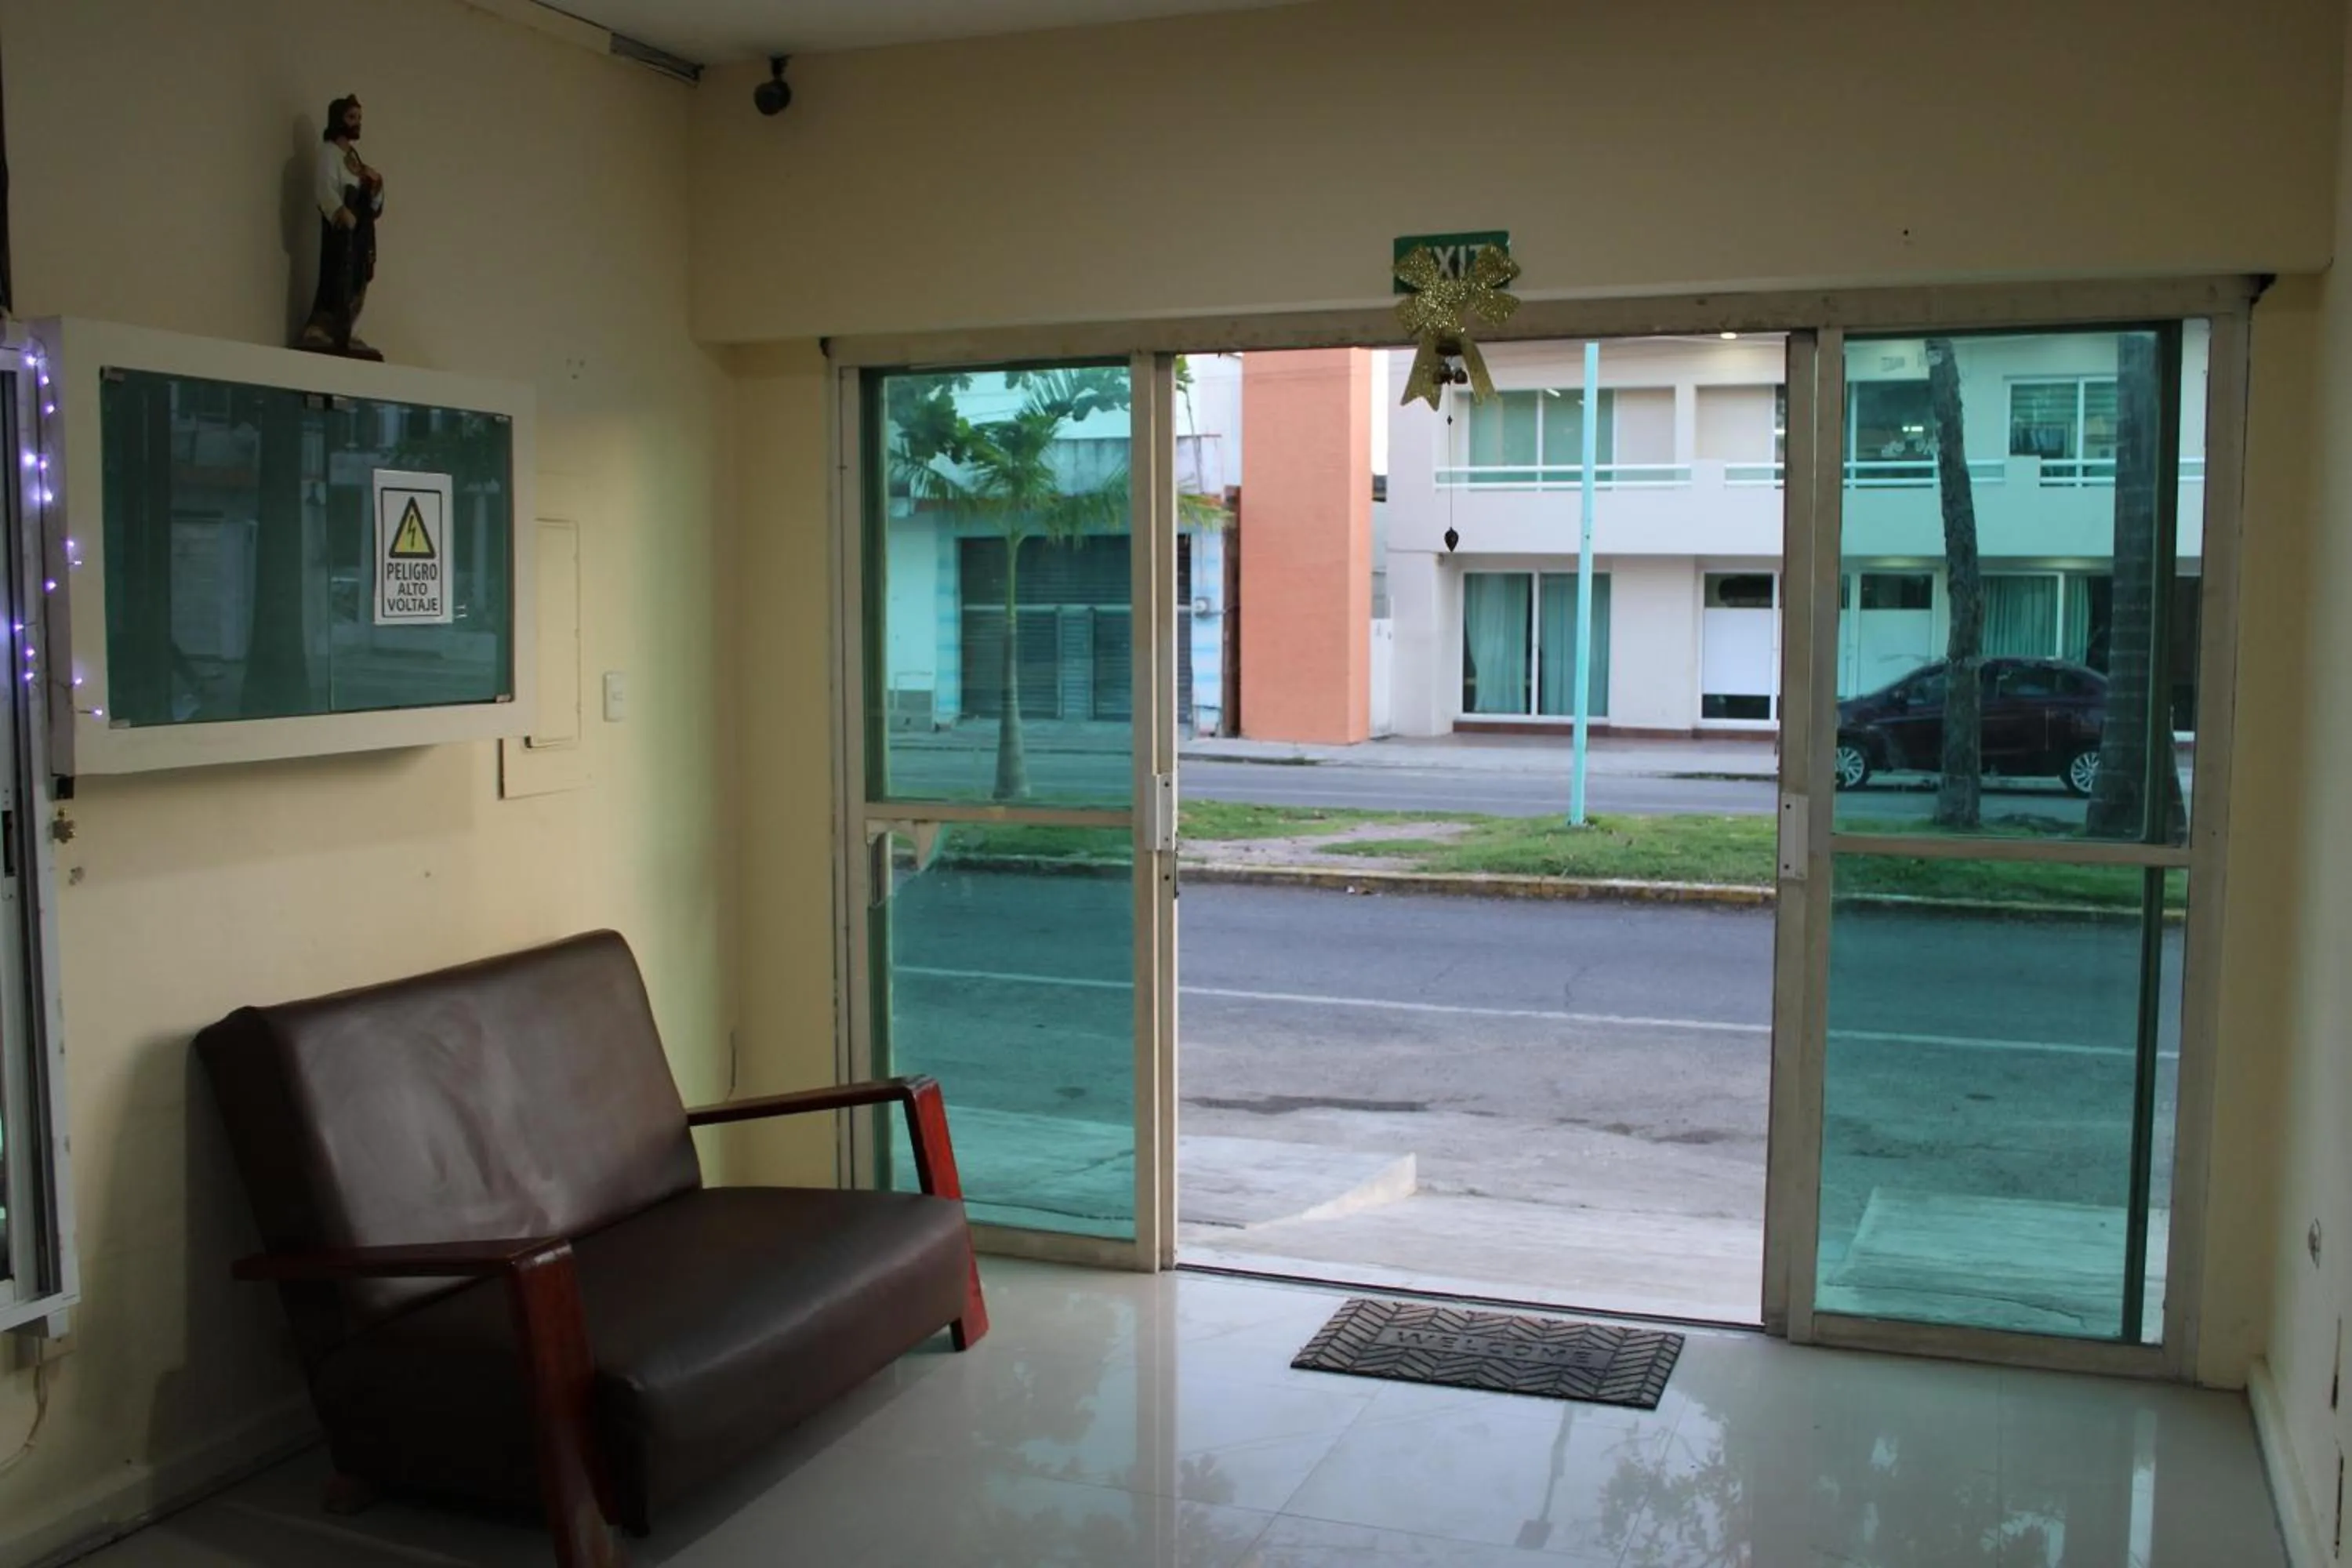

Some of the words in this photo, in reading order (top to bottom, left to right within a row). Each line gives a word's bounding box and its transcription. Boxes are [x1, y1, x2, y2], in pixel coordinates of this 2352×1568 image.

[1419, 243, 1490, 281] XI
[387, 562, 437, 580] PELIGRO
[397, 583, 427, 596] ALTO
[387, 597, 437, 612] VOLTAJE
[1397, 1331, 1592, 1364] WELCOME
